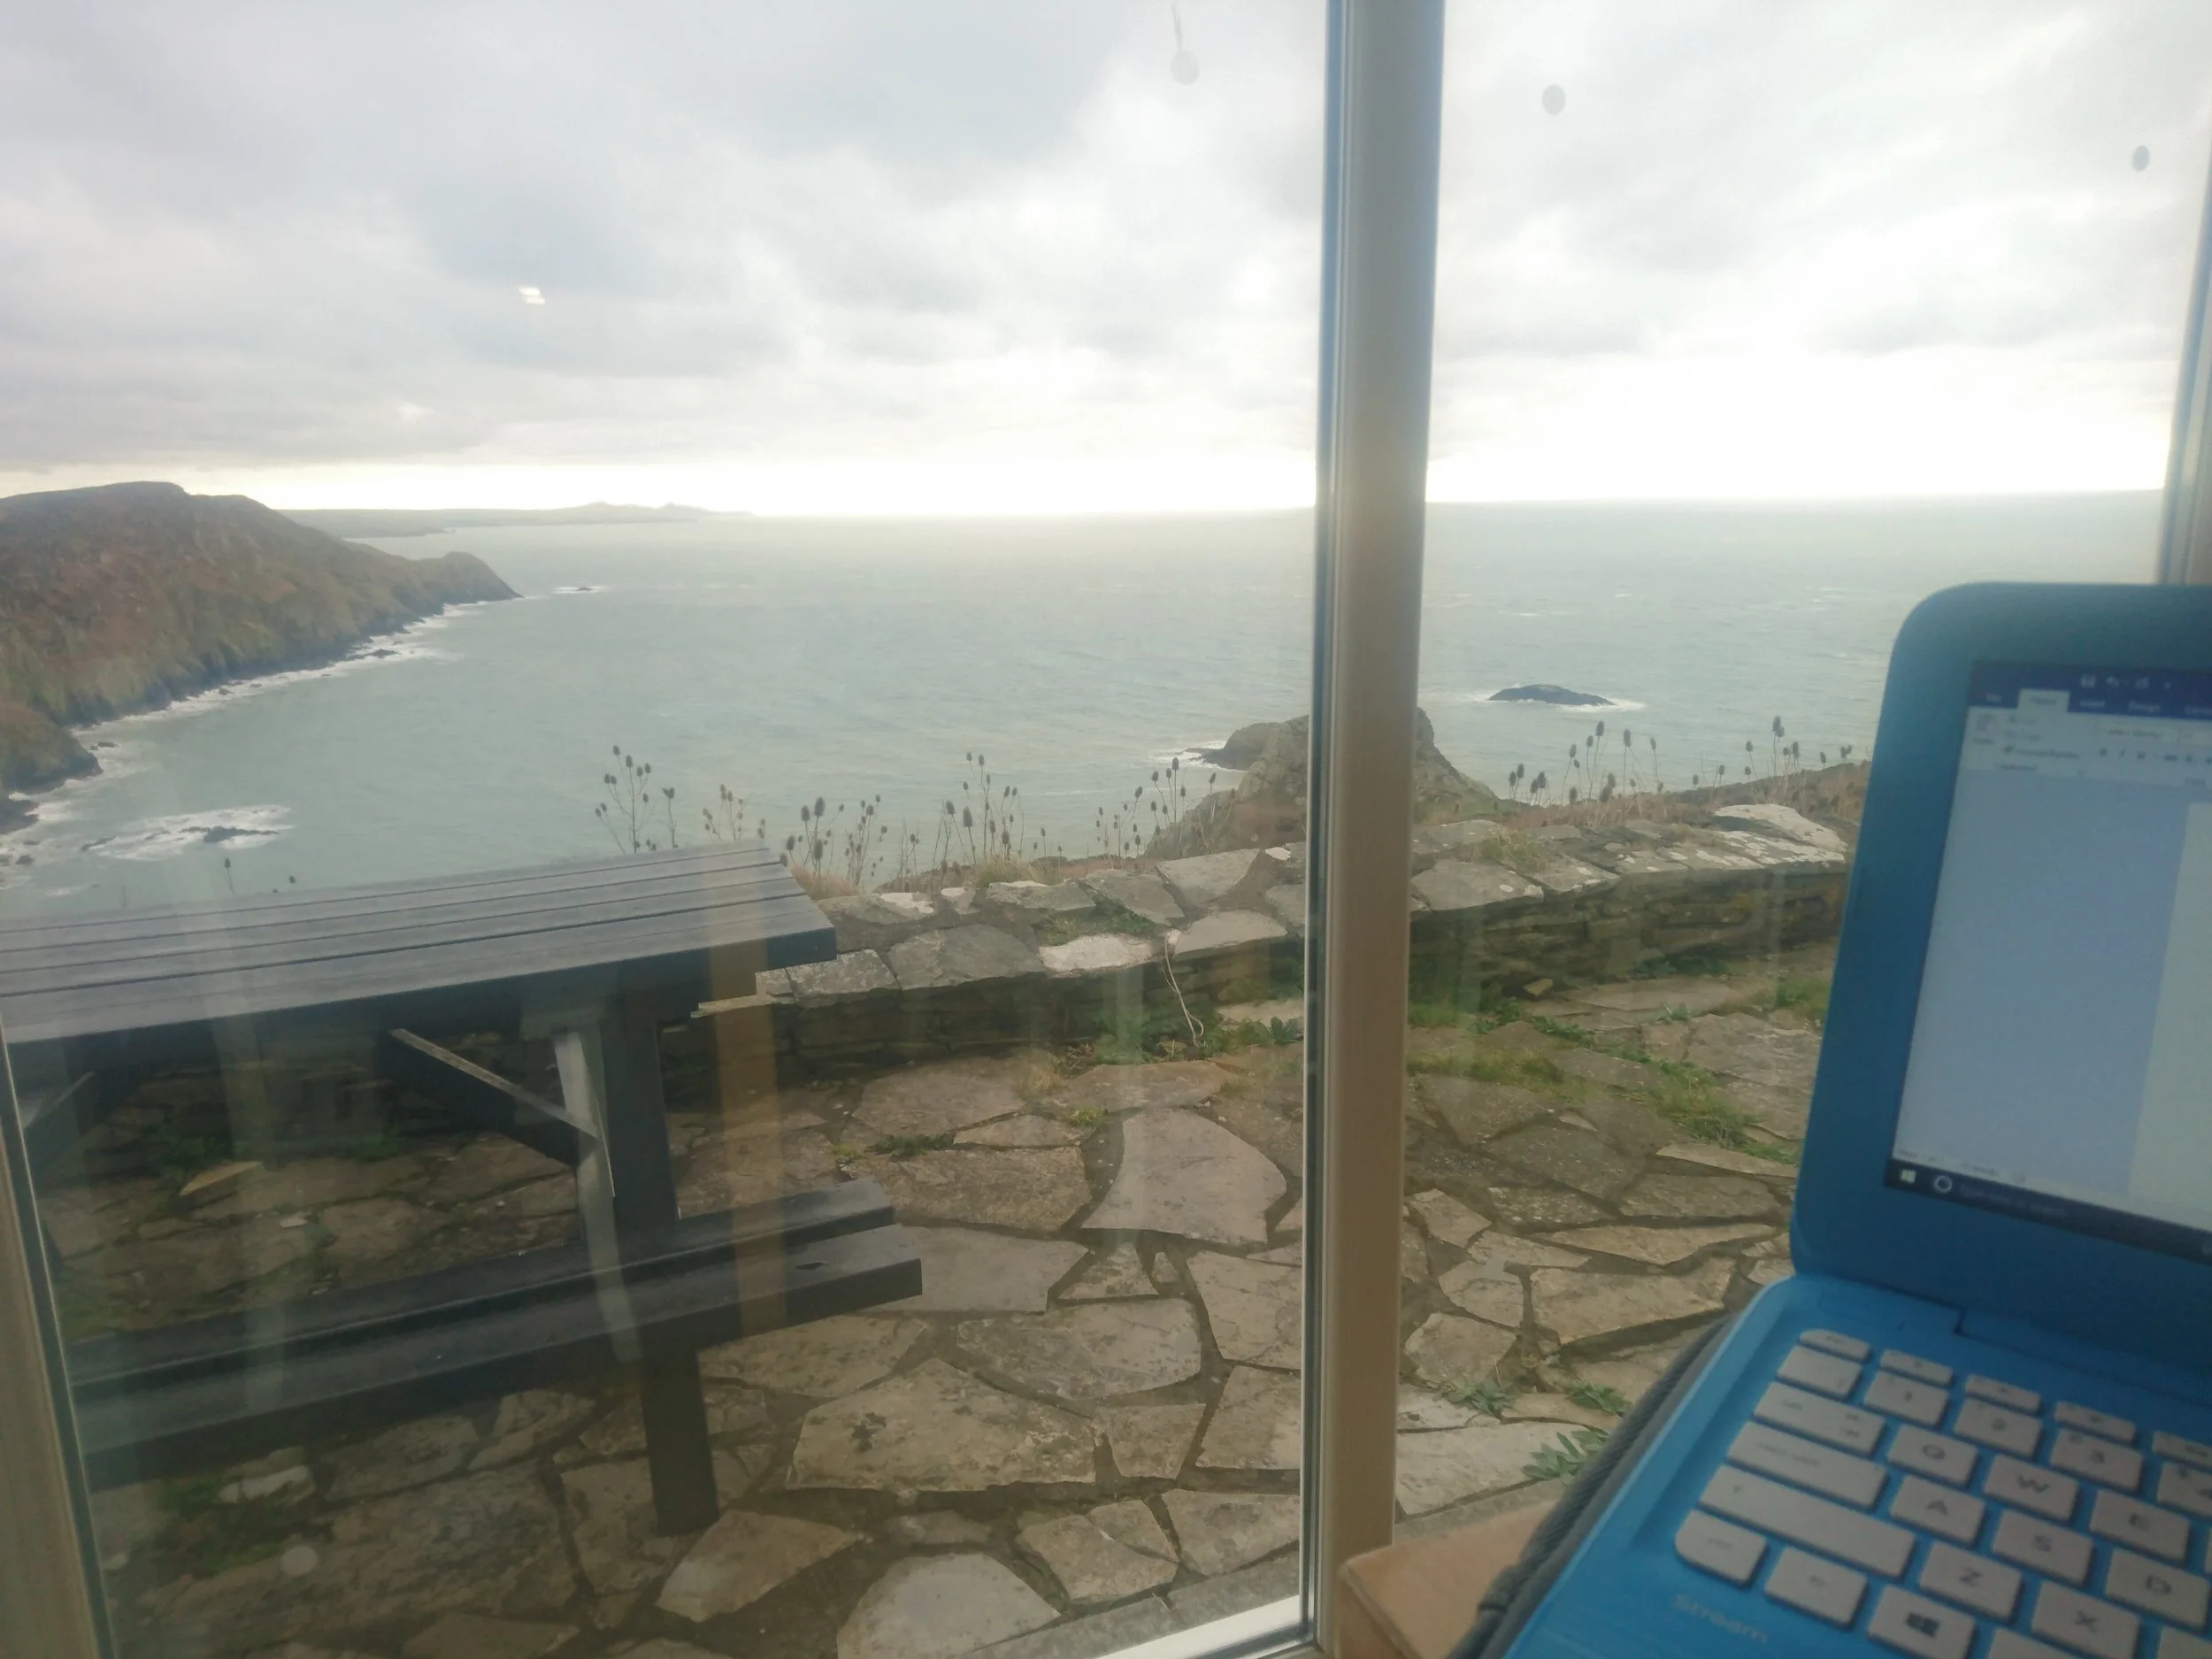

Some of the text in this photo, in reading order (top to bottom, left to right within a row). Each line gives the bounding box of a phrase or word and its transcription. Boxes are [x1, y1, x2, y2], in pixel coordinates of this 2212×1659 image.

[2016, 1474, 2050, 1494] W
[1926, 1501, 1949, 1517] A
[1959, 1567, 1983, 1587] Z
[2074, 1609, 2098, 1633] X
